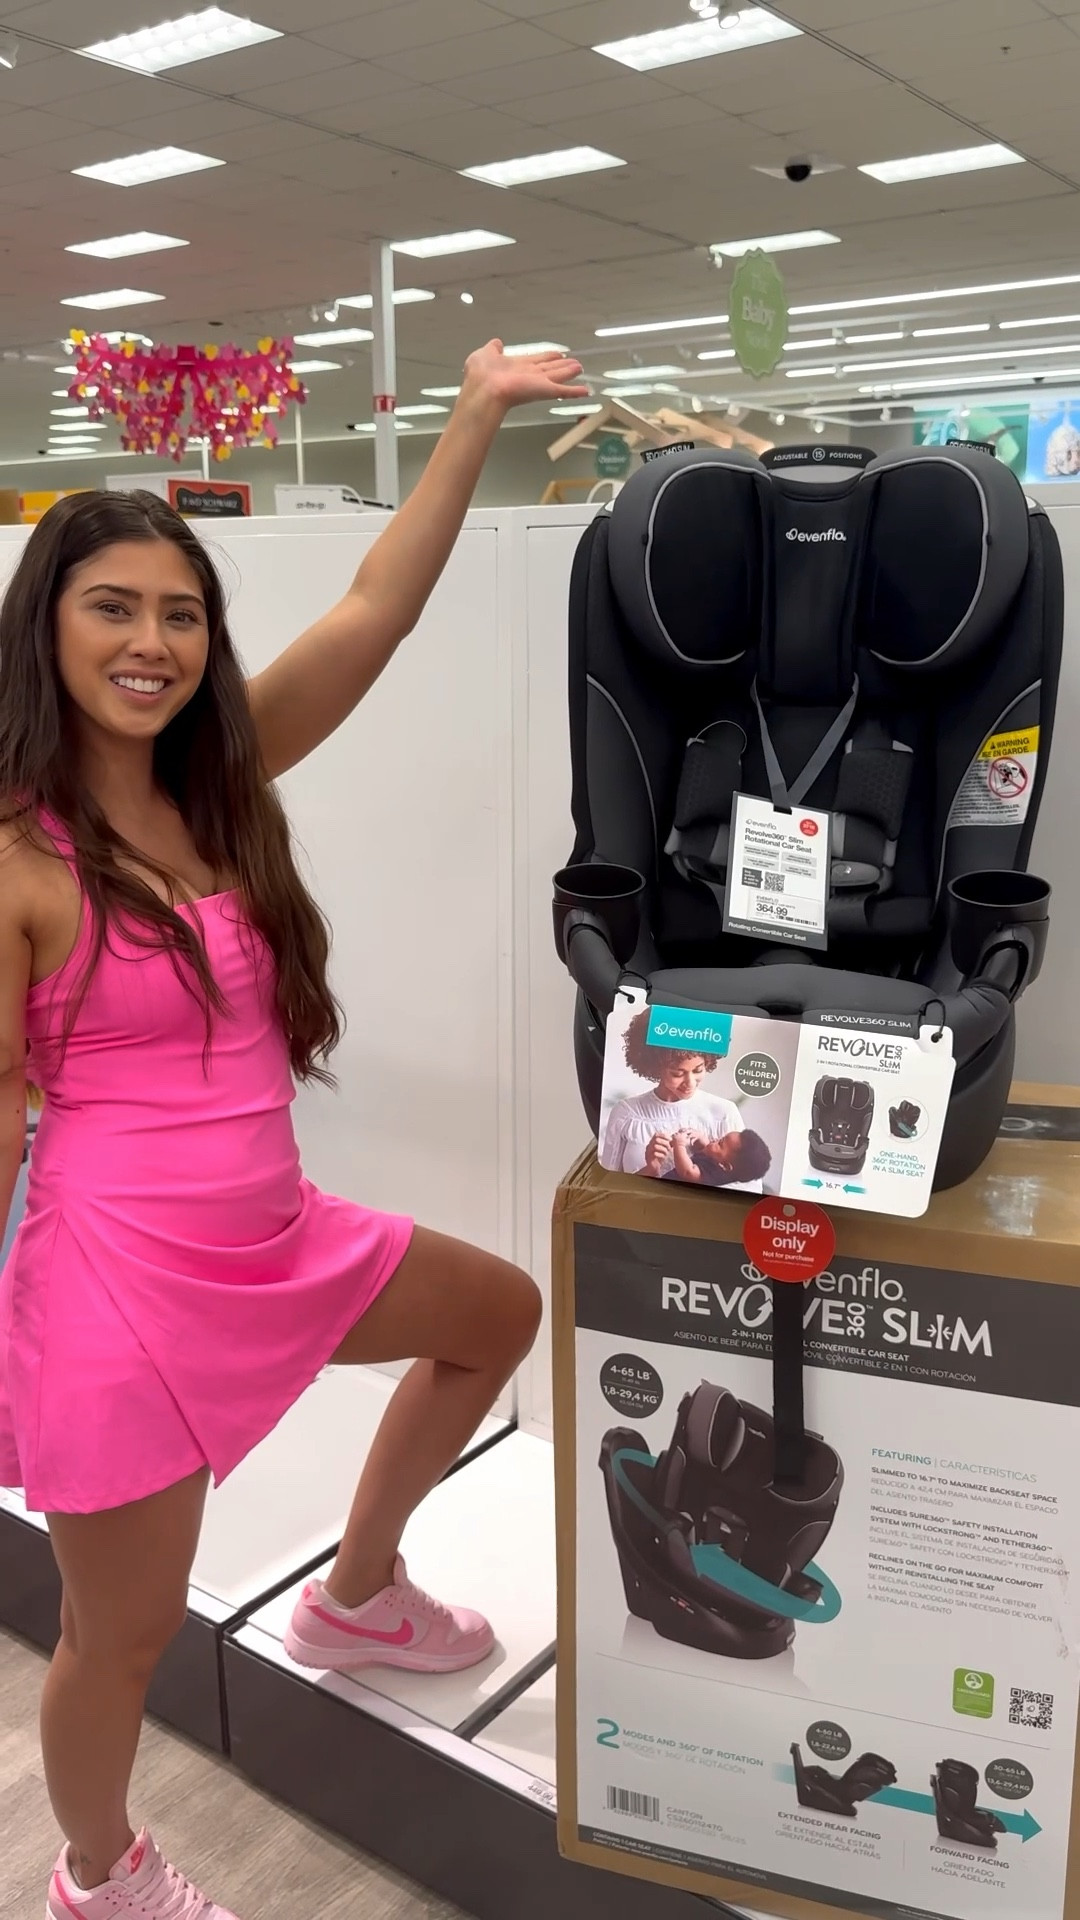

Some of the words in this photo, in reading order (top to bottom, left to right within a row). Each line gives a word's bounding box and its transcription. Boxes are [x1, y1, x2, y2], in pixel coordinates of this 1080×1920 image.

[742, 296, 775, 331] Baby
[773, 452, 808, 461] ADJUSTABLE
[814, 450, 823, 458] 15
[829, 452, 862, 460] POSITIONS
[797, 528, 843, 543] evenflo
[997, 738, 1029, 748] WARNING
[1002, 746, 1029, 756] GARDE
[752, 820, 777, 831] evenflo
[744, 834, 780, 847] Rotational
[781, 841, 794, 850] Car
[796, 844, 812, 854] Seat
[788, 836, 804, 845] Slim
[756, 903, 788, 917] 364.99
[728, 921, 750, 932] Rotating
[752, 926, 782, 936] Convertible
[887, 1020, 912, 1028] SLIM
[668, 1027, 722, 1043] evenflo
[750, 1060, 767, 1069] FITS
[853, 1064, 881, 1072] CONVERTIBLE
[879, 1059, 901, 1070] SLIM
[737, 1068, 777, 1080] CHILDREN
[740, 1079, 759, 1088] 4-65
[761, 1081, 771, 1089] LB
[879, 1150, 919, 1162] ONE-HAND,
[888, 1166, 904, 1175] SLIM
[905, 1170, 925, 1178] SEAT
[889, 1159, 926, 1171] ROTATION
[760, 1215, 820, 1238] Display
[772, 1235, 807, 1253] only
[762, 1250, 774, 1258] Not
[775, 1251, 784, 1259] for
[784, 1253, 815, 1263] purchase
[882, 1306, 993, 1357] SLIM
[731, 1328, 755, 1340] 2-IN-1
[809, 1340, 866, 1356] CONVERTIBLE
[867, 1349, 887, 1359] CAR
[887, 1352, 910, 1362] SEAT
[673, 1331, 707, 1342] ASIENTO
[708, 1336, 719, 1344] DE
[741, 1341, 764, 1351] PARA
[825, 1352, 882, 1370] CONVERTIBLE
[883, 1362, 890, 1370] 2
[891, 1363, 903, 1372] EN
[910, 1366, 929, 1376] CON
[930, 1369, 977, 1383] ROTACIÓN
[610, 1364, 634, 1377] 4-65
[603, 1385, 641, 1401] 1,8-29,4
[871, 1448, 932, 1466] FEATURING
[940, 1459, 1038, 1484] CARACTERÍSTICAS
[871, 1466, 906, 1478] SLIMMED
[907, 1472, 918, 1480] TO
[937, 1477, 949, 1485] TO
[950, 1480, 988, 1492] MAXIMIZE
[989, 1486, 1030, 1499] BACKSEAT
[1032, 1493, 1058, 1504] SPACE
[870, 1488, 884, 1496] DEL
[886, 1490, 918, 1502] ASIENTO
[919, 1496, 954, 1508] TRASERO
[871, 1477, 908, 1489] REDUCIDO
[933, 1488, 947, 1496] CM
[948, 1490, 969, 1500] PARA
[970, 1494, 1012, 1507] MAXIMIZAR
[1014, 1501, 1024, 1509] EL
[1025, 1503, 1059, 1515] ESPACIO
[870, 1505, 907, 1517] INCLUDES
[952, 1519, 981, 1530] SAFETY
[982, 1525, 1039, 1540] INSTALLATION
[870, 1515, 899, 1526] SYSTEM
[901, 1520, 922, 1530] WITH
[982, 1535, 1000, 1544] AND
[911, 1533, 943, 1545] SISTEMA
[944, 1538, 954, 1546] DE
[1007, 1550, 1017, 1558] DE
[937, 1548, 954, 1557] CON
[868, 1552, 904, 1565] RECLINES
[905, 1559, 918, 1567] ON
[919, 1561, 934, 1570] THE
[934, 1564, 947, 1572] GO
[948, 1566, 965, 1576] FOR
[966, 1570, 1004, 1583] MAXIMUM
[1005, 1577, 1044, 1589] COMFORT
[868, 1563, 903, 1575] WITHOUT
[904, 1569, 958, 1585] REINSTALLING
[960, 1579, 974, 1588] THE
[976, 1582, 995, 1591] SEAT
[867, 1583, 877, 1591] LA
[909, 1591, 954, 1605] COMODIDAD
[955, 1599, 967, 1608] SIN
[969, 1602, 1011, 1616] NECESIDAD
[1012, 1609, 1023, 1618] DE
[1023, 1611, 1053, 1624] VOLVER
[910, 1580, 942, 1592] CUANDO
[980, 1592, 1001, 1603] PARA
[1002, 1597, 1037, 1610] OBTENER
[874, 1594, 909, 1606] INSTALAR
[920, 1603, 953, 1615] ASIENTO
[596, 1717, 620, 1749] 2
[622, 1729, 654, 1743] MODES
[656, 1737, 676, 1748] AND
[702, 1747, 714, 1756] OF
[717, 1750, 764, 1767] ROTATION
[1016, 1769, 1026, 1777] LB
[777, 1811, 822, 1827] EXTENDED
[824, 1821, 848, 1833] REAR
[850, 1828, 882, 1841] FACING
[774, 1829, 823, 1847] ORIENTADO
[824, 1841, 851, 1853] HACIA
[834, 1836, 845, 1845] AL
[847, 1838, 876, 1851] ESTAR
[929, 1845, 976, 1861] FORWARD
[976, 1855, 1010, 1869] FACING
[930, 1866, 958, 1878] HACIA
[960, 1872, 1006, 1889] ADELANTE
[942, 1861, 995, 1878] ORIENTADO
